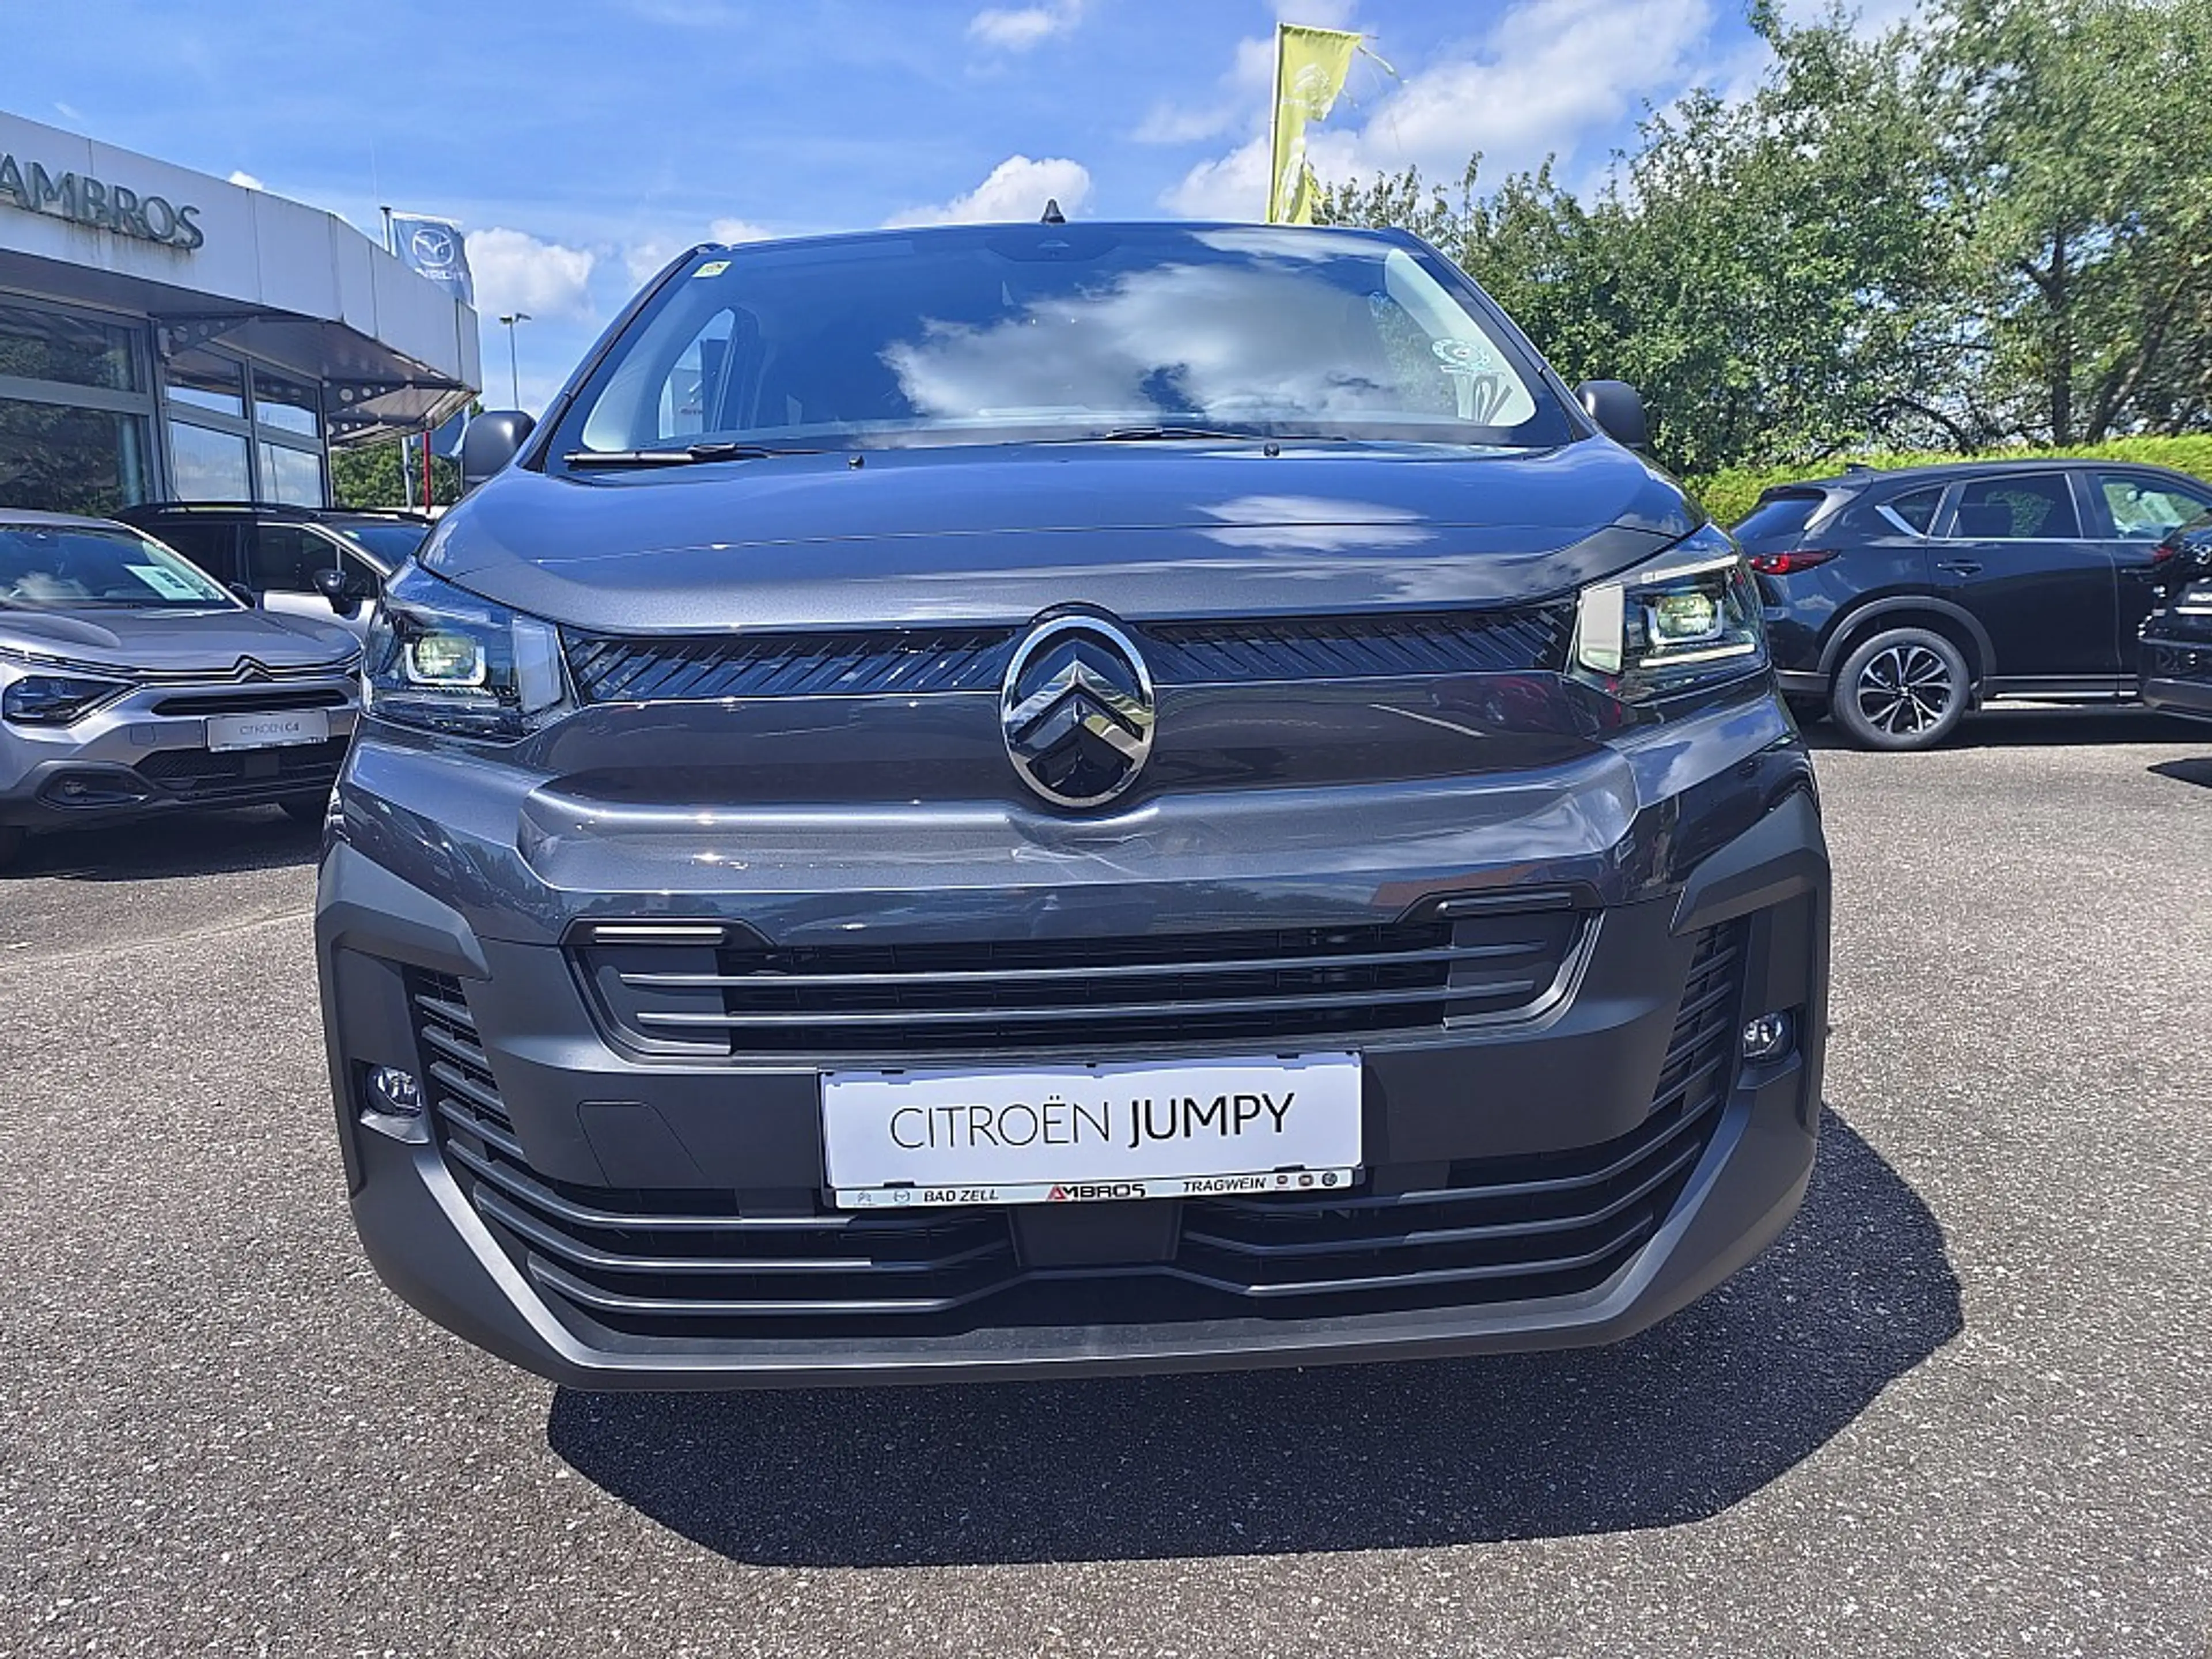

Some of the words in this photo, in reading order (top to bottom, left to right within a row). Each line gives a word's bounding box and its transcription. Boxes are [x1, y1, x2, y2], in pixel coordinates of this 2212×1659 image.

[0, 153, 203, 249] AMBROS
[891, 1095, 1109, 1148] CITROËN
[1128, 1092, 1295, 1149] JUMPY
[1047, 1183, 1146, 1200] AMBROS
[1182, 1177, 1266, 1193] TRAGWEIN
[924, 1190, 955, 1203] BAD
[960, 1189, 998, 1202] ZELL
